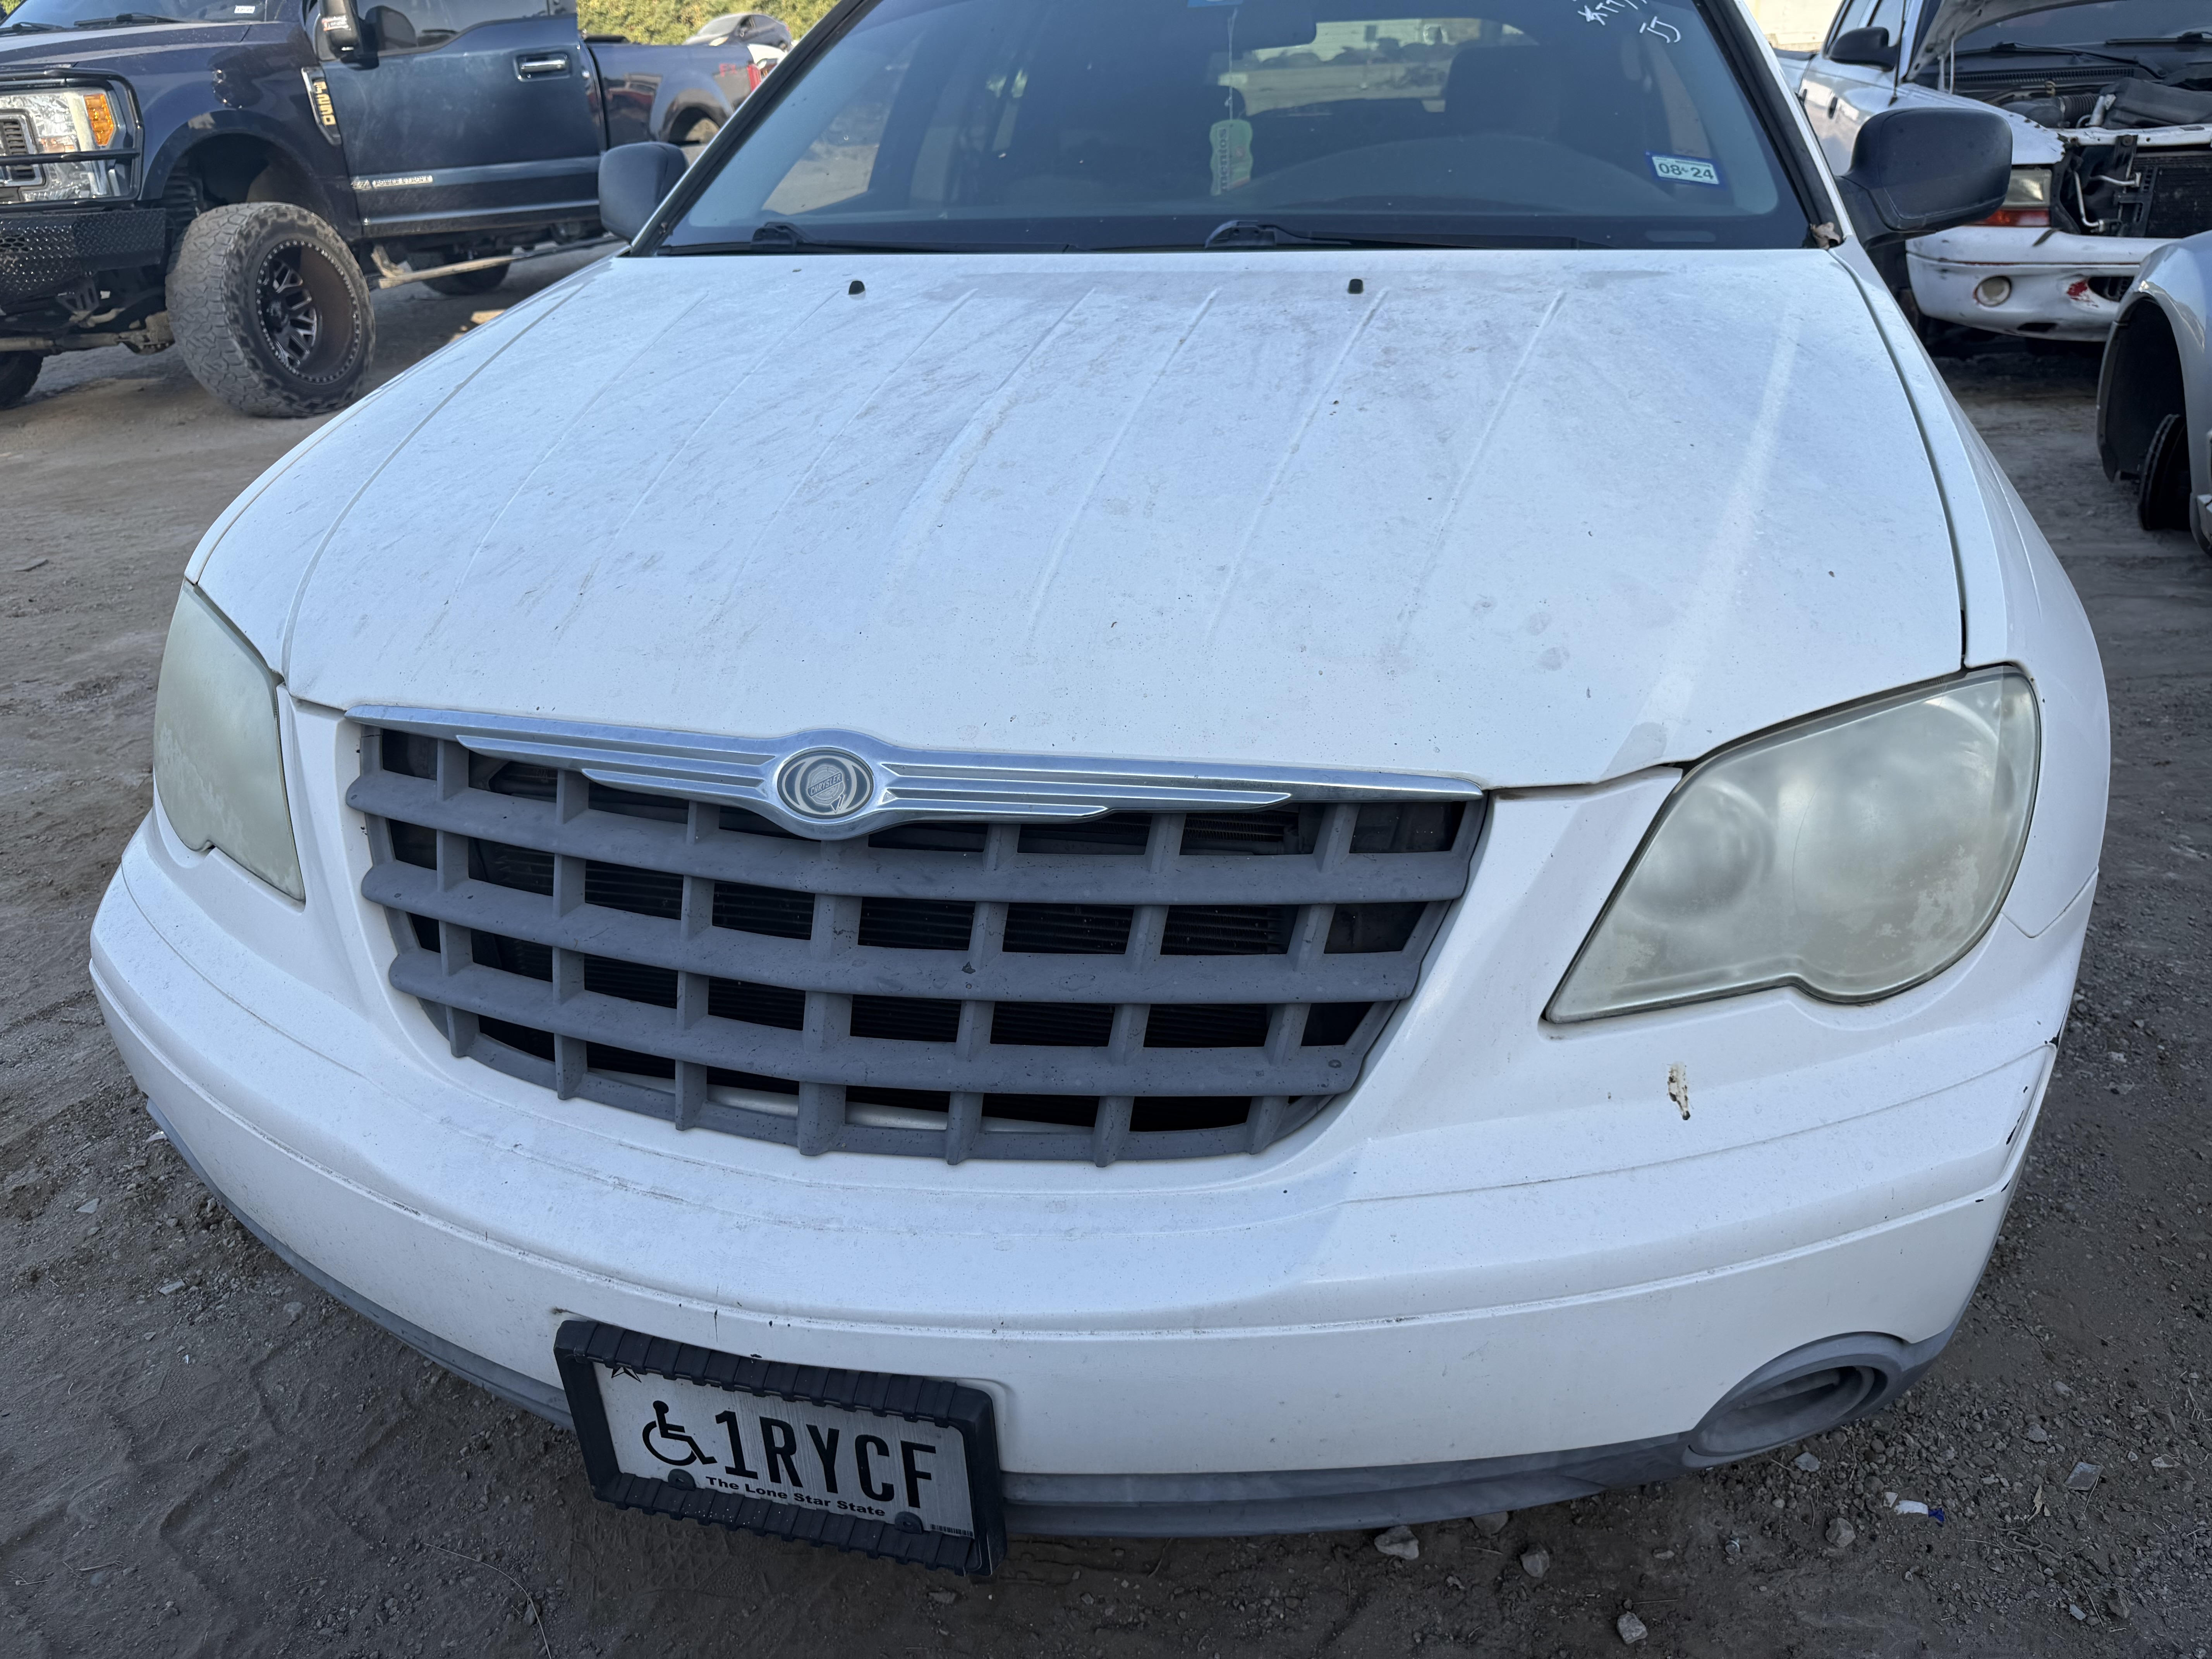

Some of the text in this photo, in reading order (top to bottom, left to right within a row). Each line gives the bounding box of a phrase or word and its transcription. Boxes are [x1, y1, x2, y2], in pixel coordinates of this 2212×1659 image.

[314, 81, 336, 125] F250
[811, 773, 841, 795] CHRYSLER
[715, 1410, 936, 1509] 1RYCF
[706, 1476, 886, 1516] The Lone Star State
